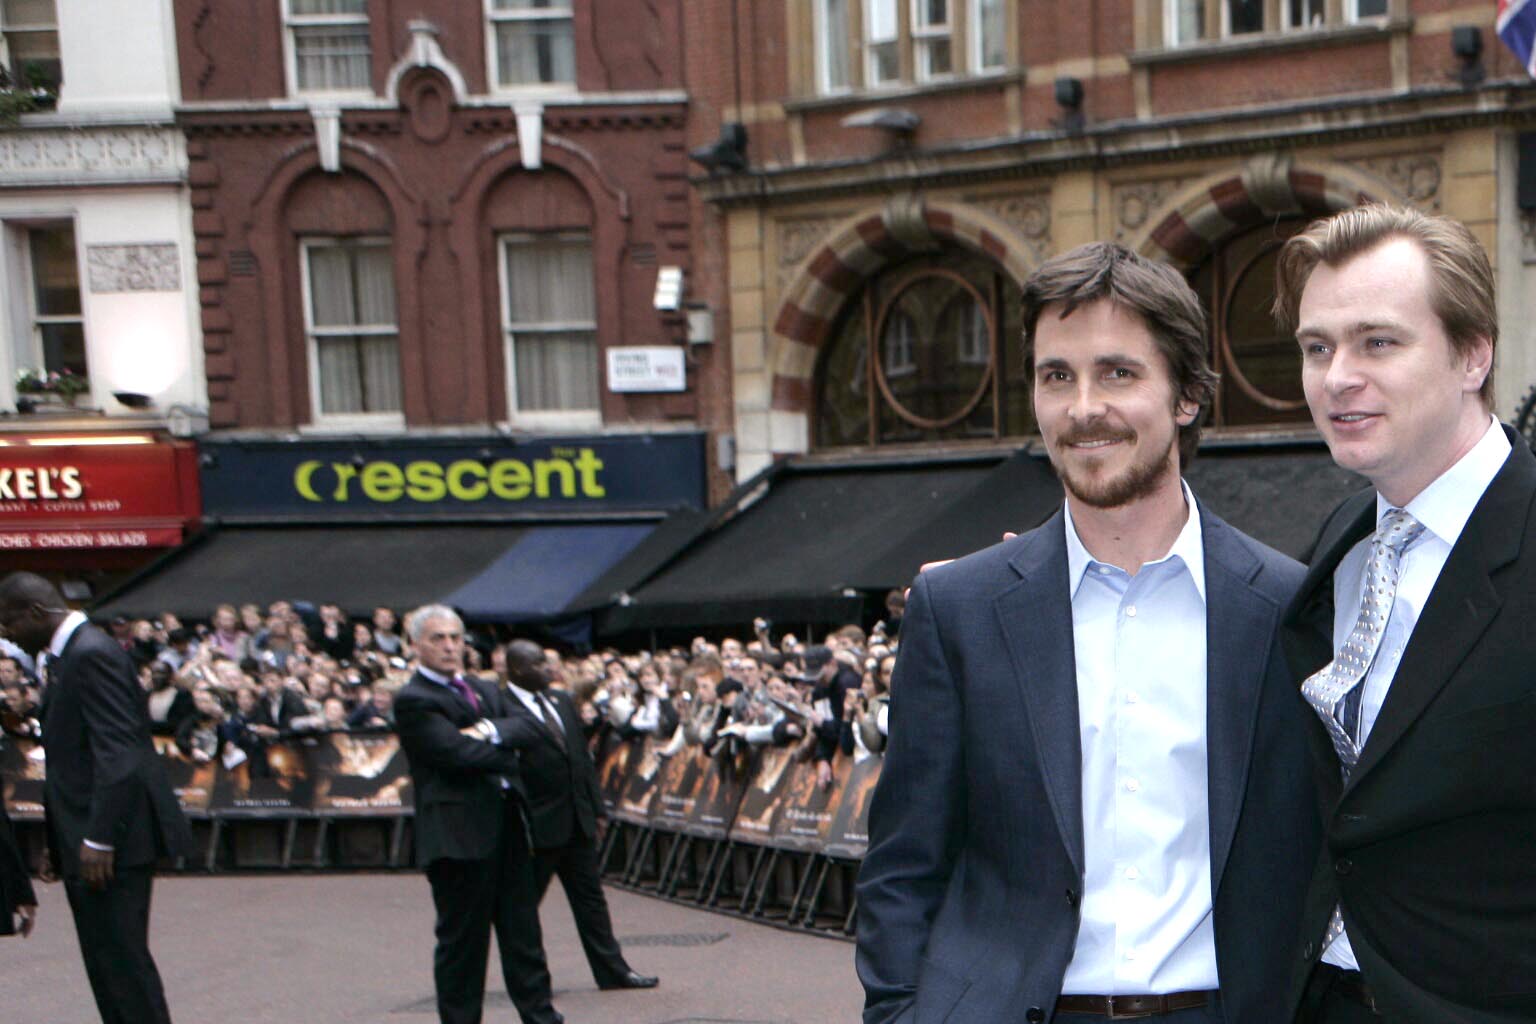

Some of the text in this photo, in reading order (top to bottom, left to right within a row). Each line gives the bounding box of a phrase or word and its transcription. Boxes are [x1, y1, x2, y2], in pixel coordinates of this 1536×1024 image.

[0, 531, 148, 548] CHES CHICKEN SALADS
